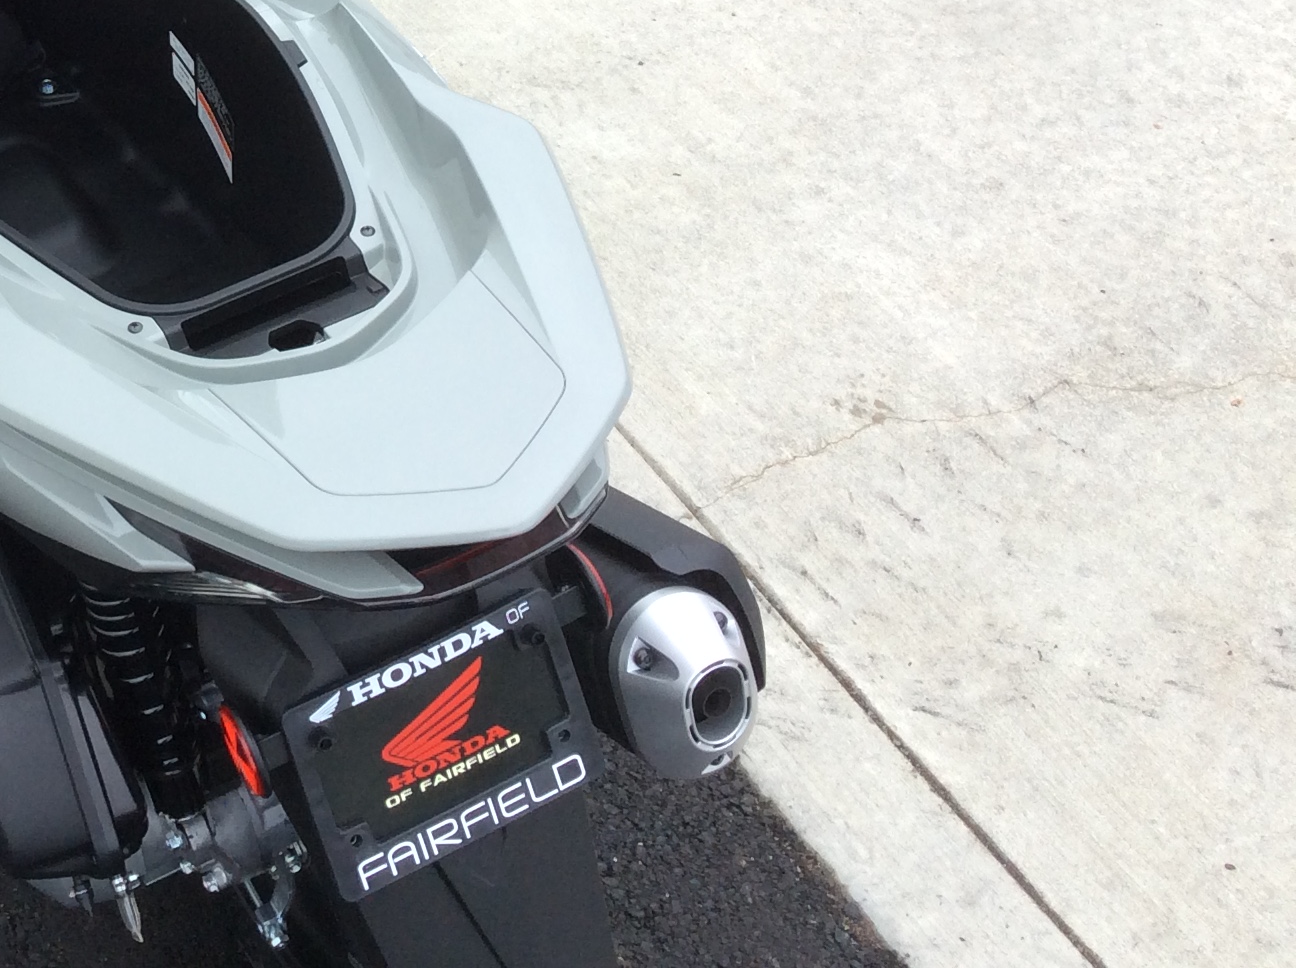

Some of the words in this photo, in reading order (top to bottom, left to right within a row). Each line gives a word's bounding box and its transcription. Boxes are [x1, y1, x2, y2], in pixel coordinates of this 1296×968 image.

[347, 620, 504, 706] HONDA
[505, 601, 530, 624] OF
[385, 788, 413, 809] OF
[419, 733, 521, 792] FAIRFIELD
[387, 725, 511, 791] HONDA
[357, 754, 586, 891] FAIRFIELD
